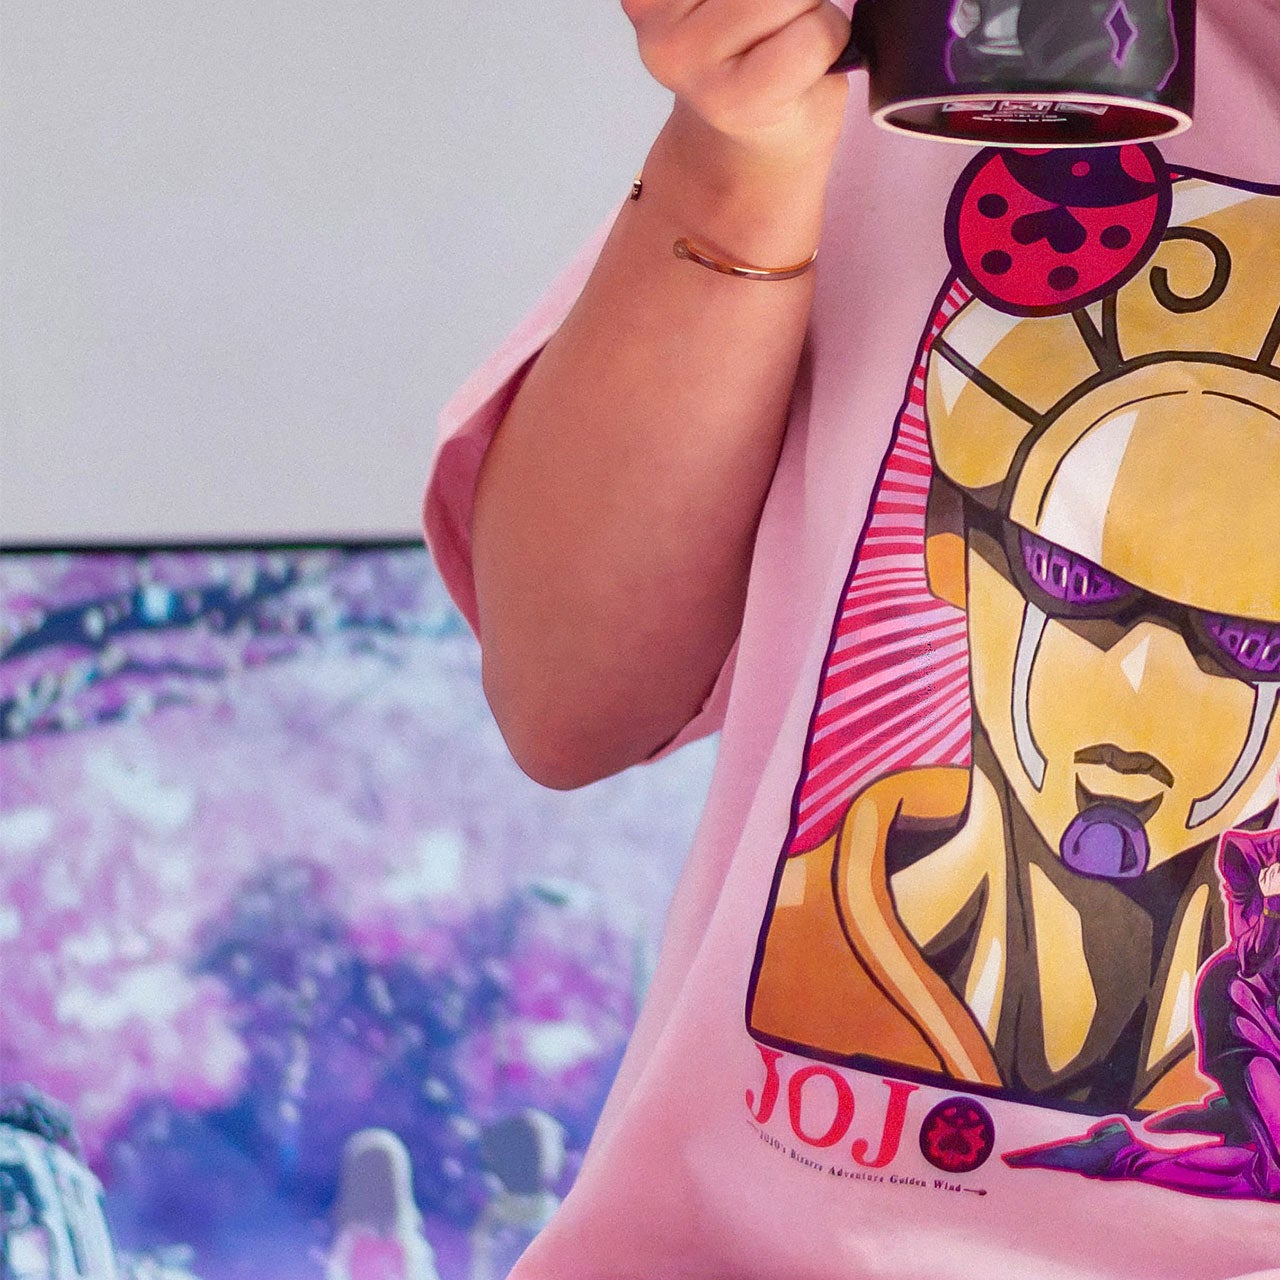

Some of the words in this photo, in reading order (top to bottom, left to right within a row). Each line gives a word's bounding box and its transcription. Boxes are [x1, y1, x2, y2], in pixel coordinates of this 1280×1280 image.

[829, 1166, 884, 1183] Adventure
[889, 1174, 927, 1188] Golden
[933, 1179, 961, 1193] Wind
